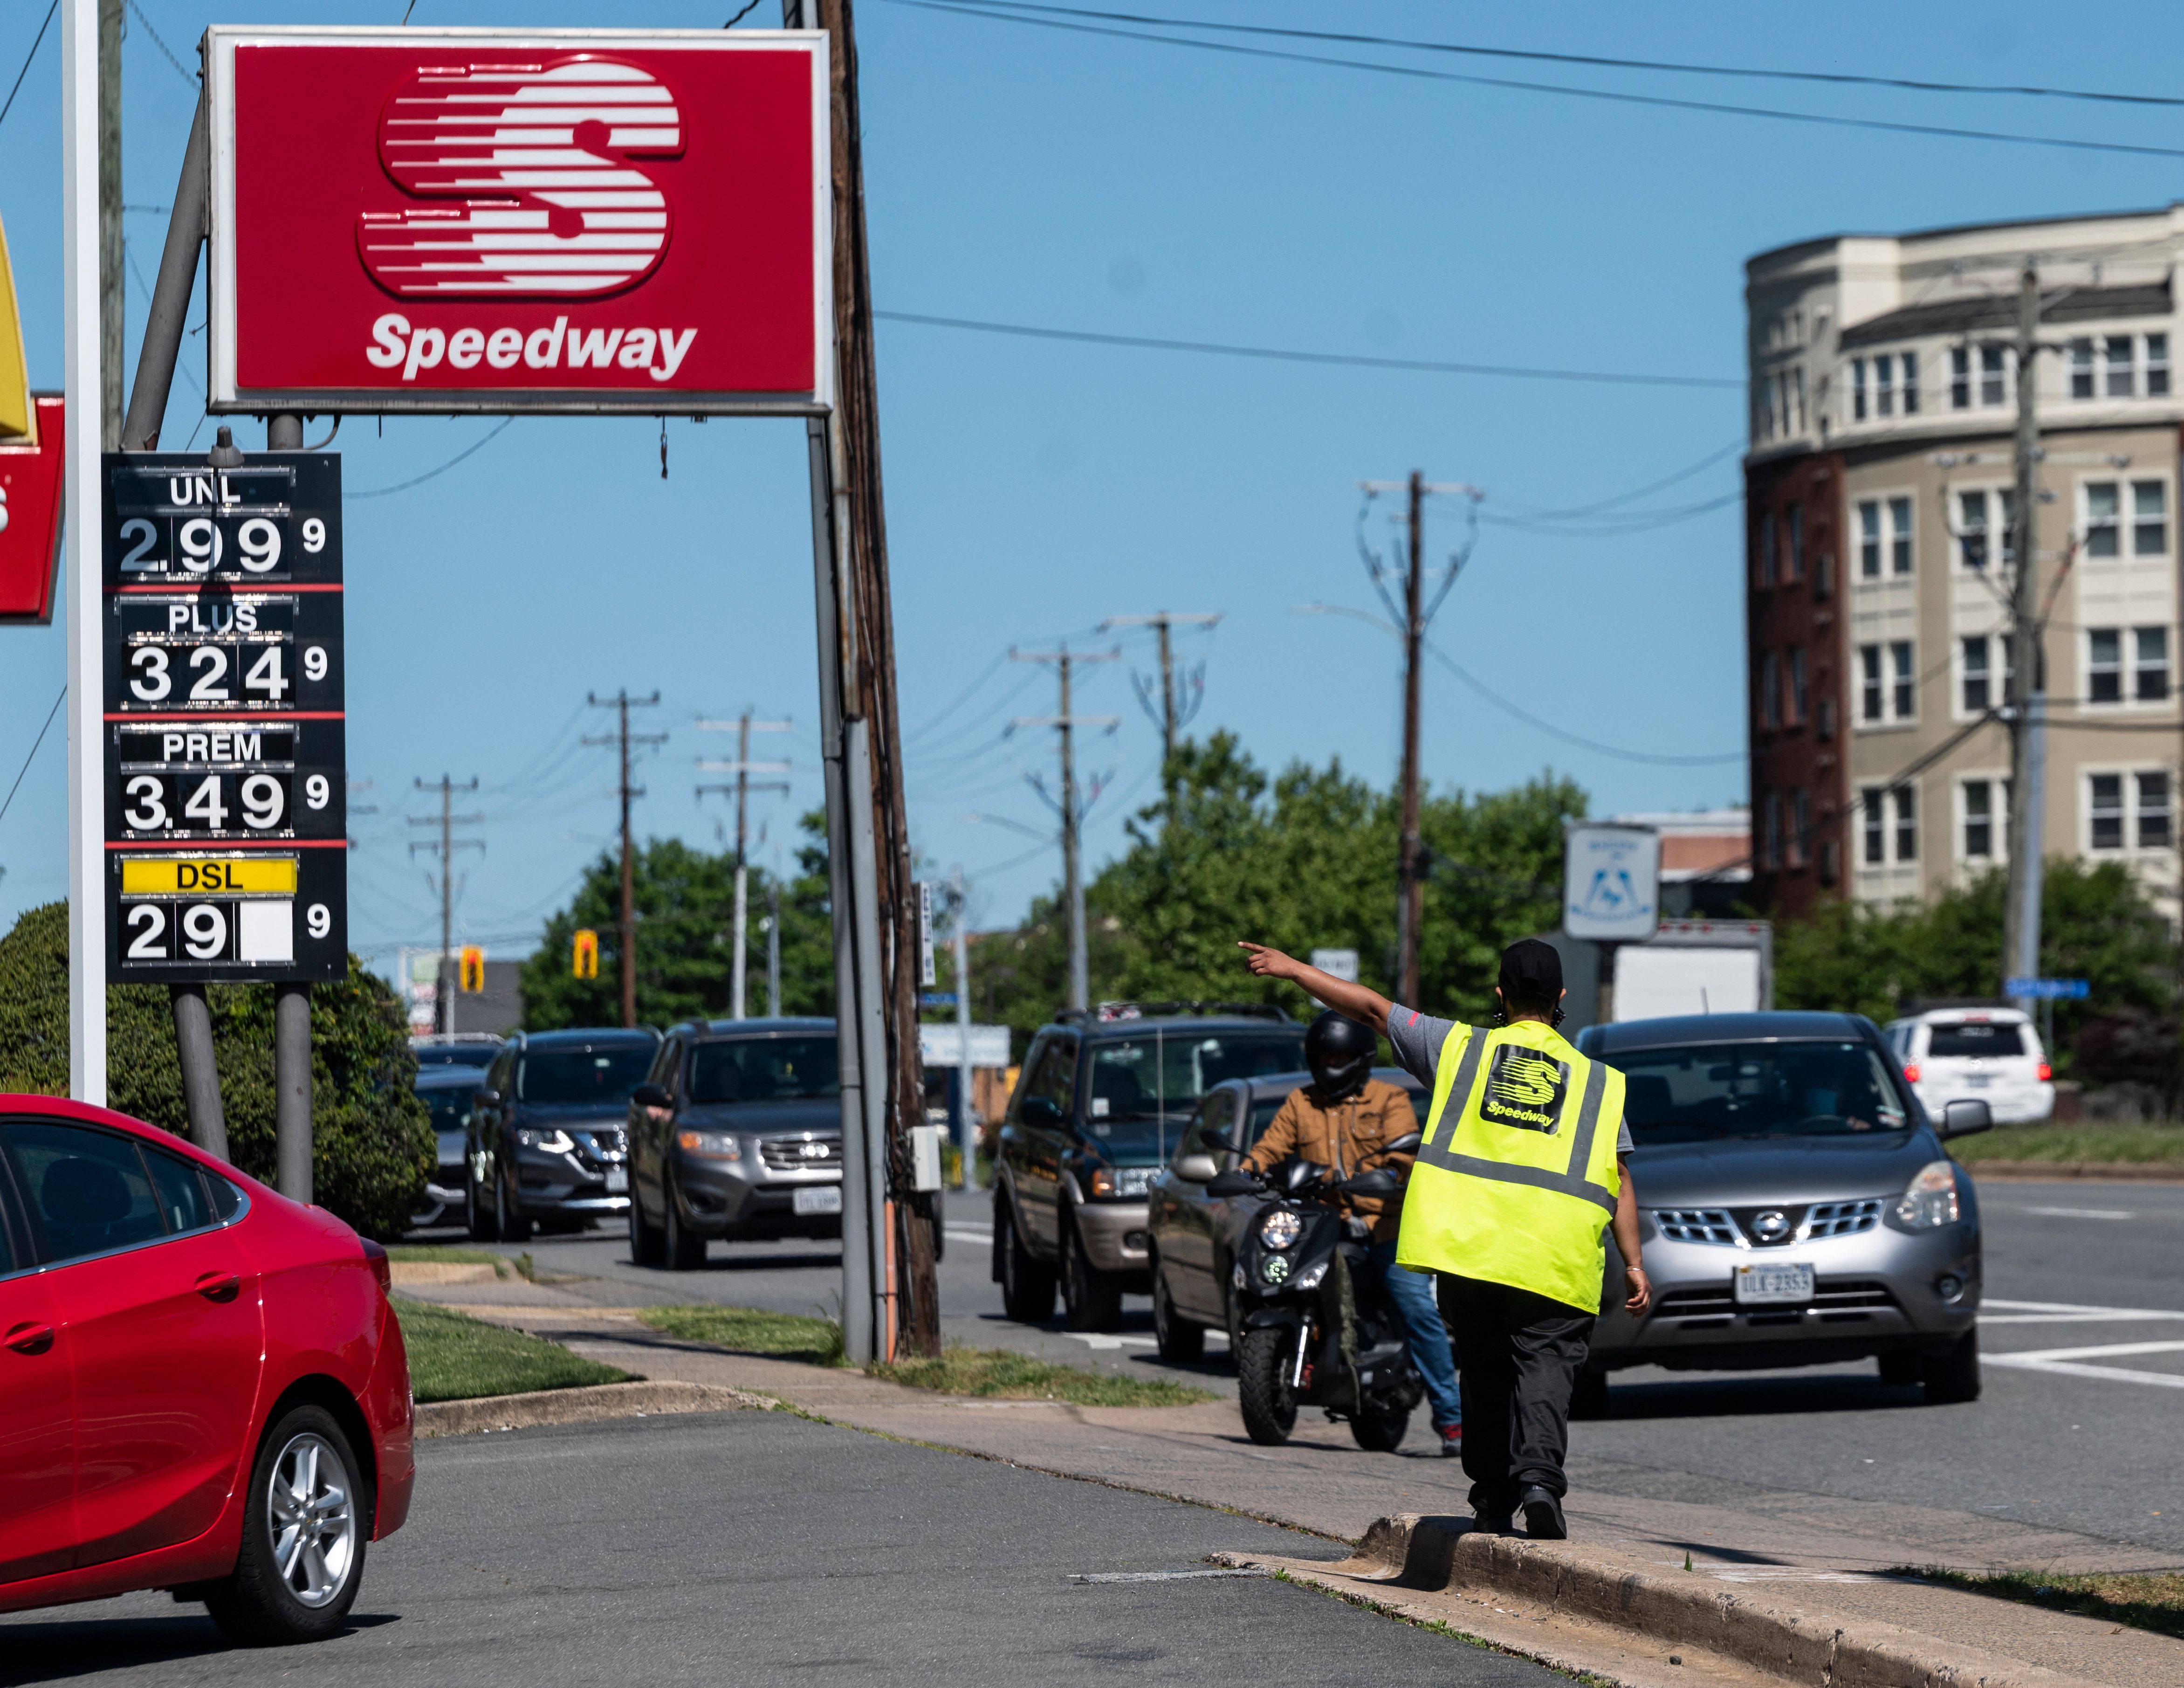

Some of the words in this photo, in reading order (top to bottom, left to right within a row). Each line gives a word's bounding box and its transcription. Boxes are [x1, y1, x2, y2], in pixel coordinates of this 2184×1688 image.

[366, 313, 698, 381] Speedway
[171, 476, 240, 505] UNL
[169, 604, 257, 633] PLUS
[164, 733, 261, 761] PREM
[177, 863, 243, 889] DSL
[1487, 1101, 1554, 1127] Speedway
